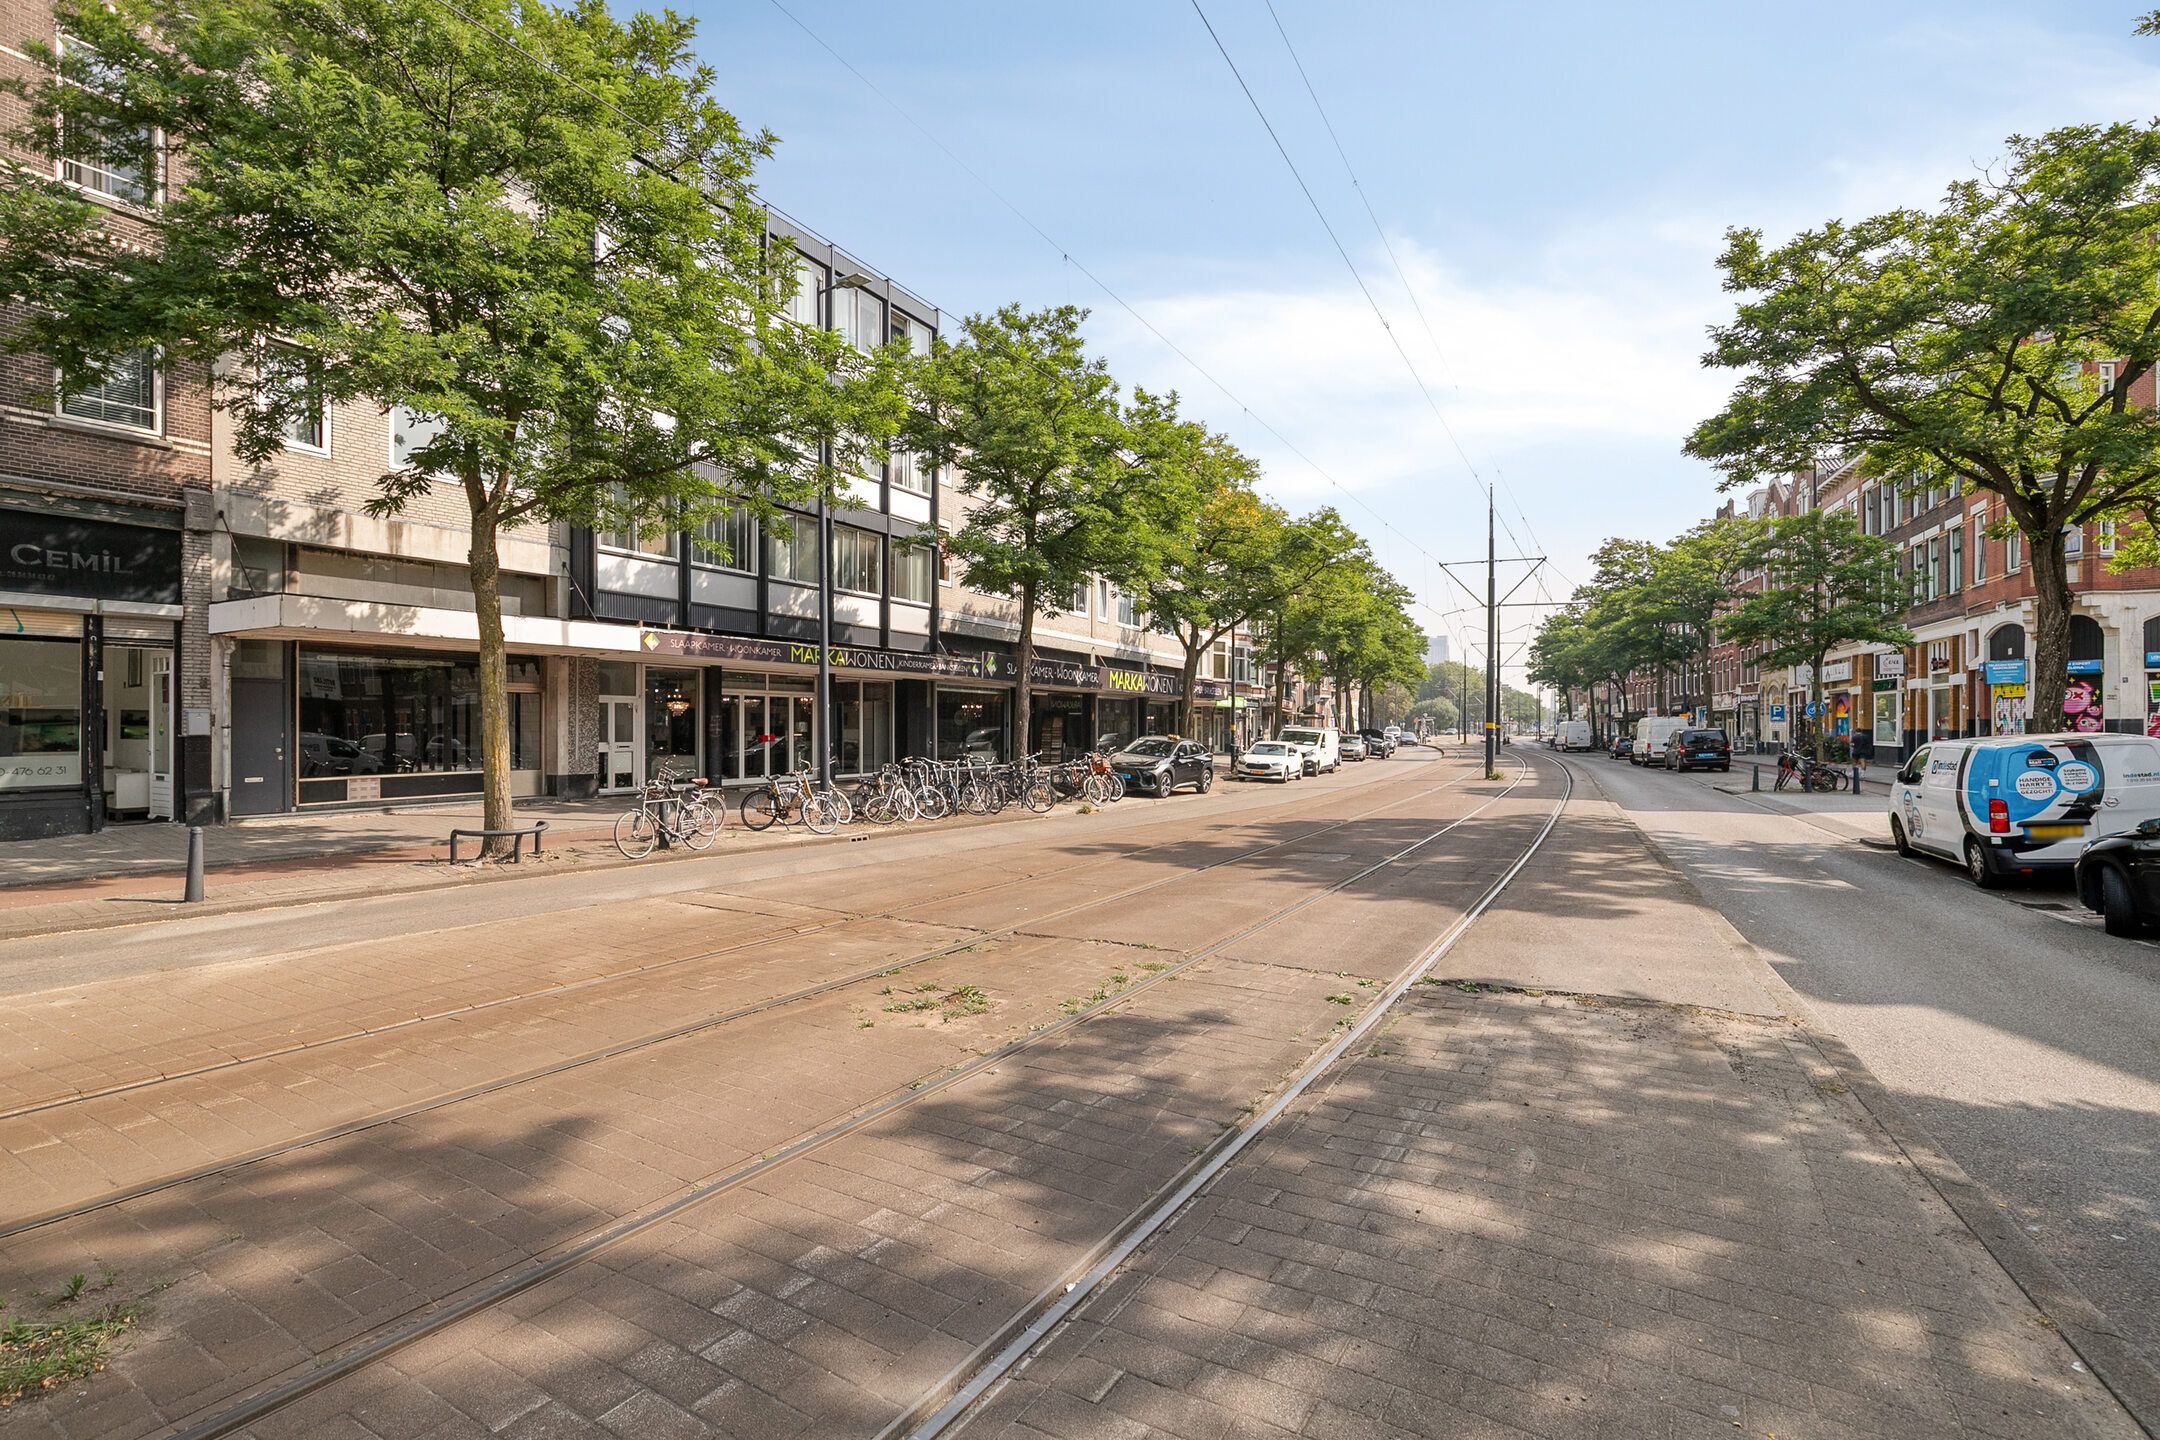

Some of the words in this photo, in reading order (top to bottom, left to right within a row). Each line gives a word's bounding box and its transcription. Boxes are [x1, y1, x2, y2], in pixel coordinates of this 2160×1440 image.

[670, 638, 726, 652] SLAAPKAMER
[729, 643, 782, 657] WOONKAMER
[1109, 670, 1174, 694] MARKAWONEN
[1773, 706, 1782, 715] P
[37, 766, 53, 775] 62
[55, 766, 67, 774] 31
